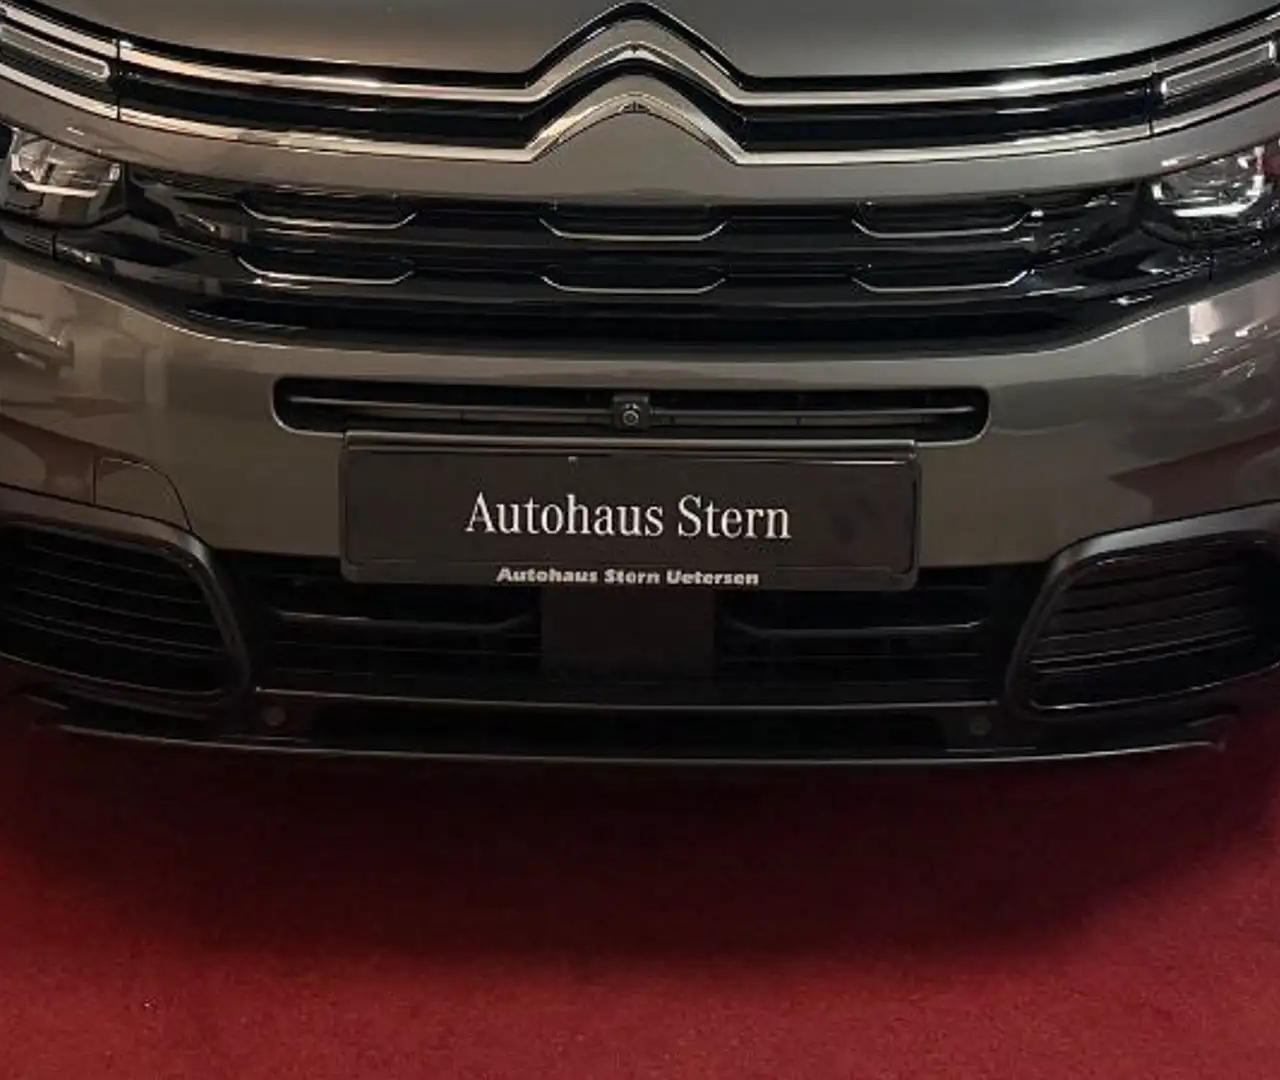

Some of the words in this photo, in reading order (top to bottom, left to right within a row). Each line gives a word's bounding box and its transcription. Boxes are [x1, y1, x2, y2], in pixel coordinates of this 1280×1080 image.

[465, 491, 665, 538] Autohaus
[677, 493, 792, 541] Stern
[495, 567, 598, 584] Autohaus
[604, 567, 660, 585] Stern
[666, 568, 759, 587] Uetersen
